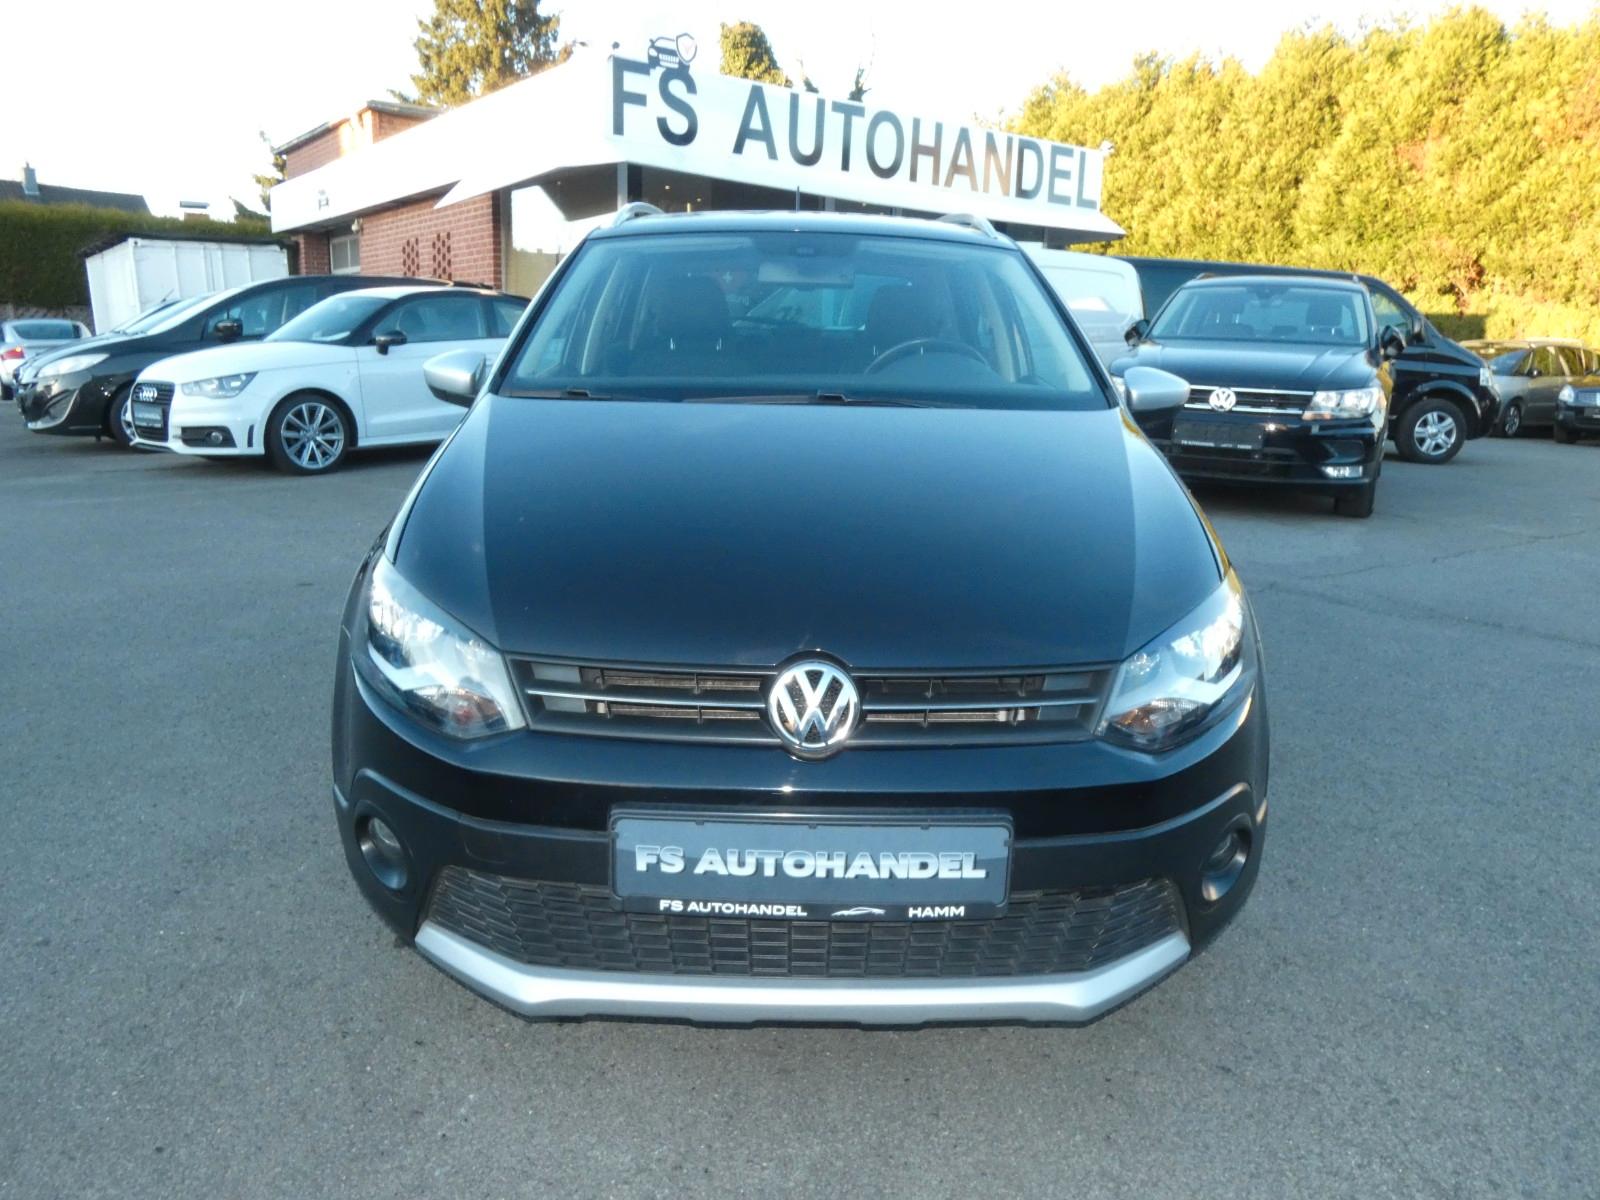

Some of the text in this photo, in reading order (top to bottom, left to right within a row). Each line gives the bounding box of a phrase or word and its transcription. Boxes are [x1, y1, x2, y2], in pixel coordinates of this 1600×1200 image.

[611, 55, 1099, 210] FS AUTOHANDEL
[635, 845, 987, 880] FS AUTOHANDEL
[659, 899, 965, 918] FS AUTOHANDEL HAMM
